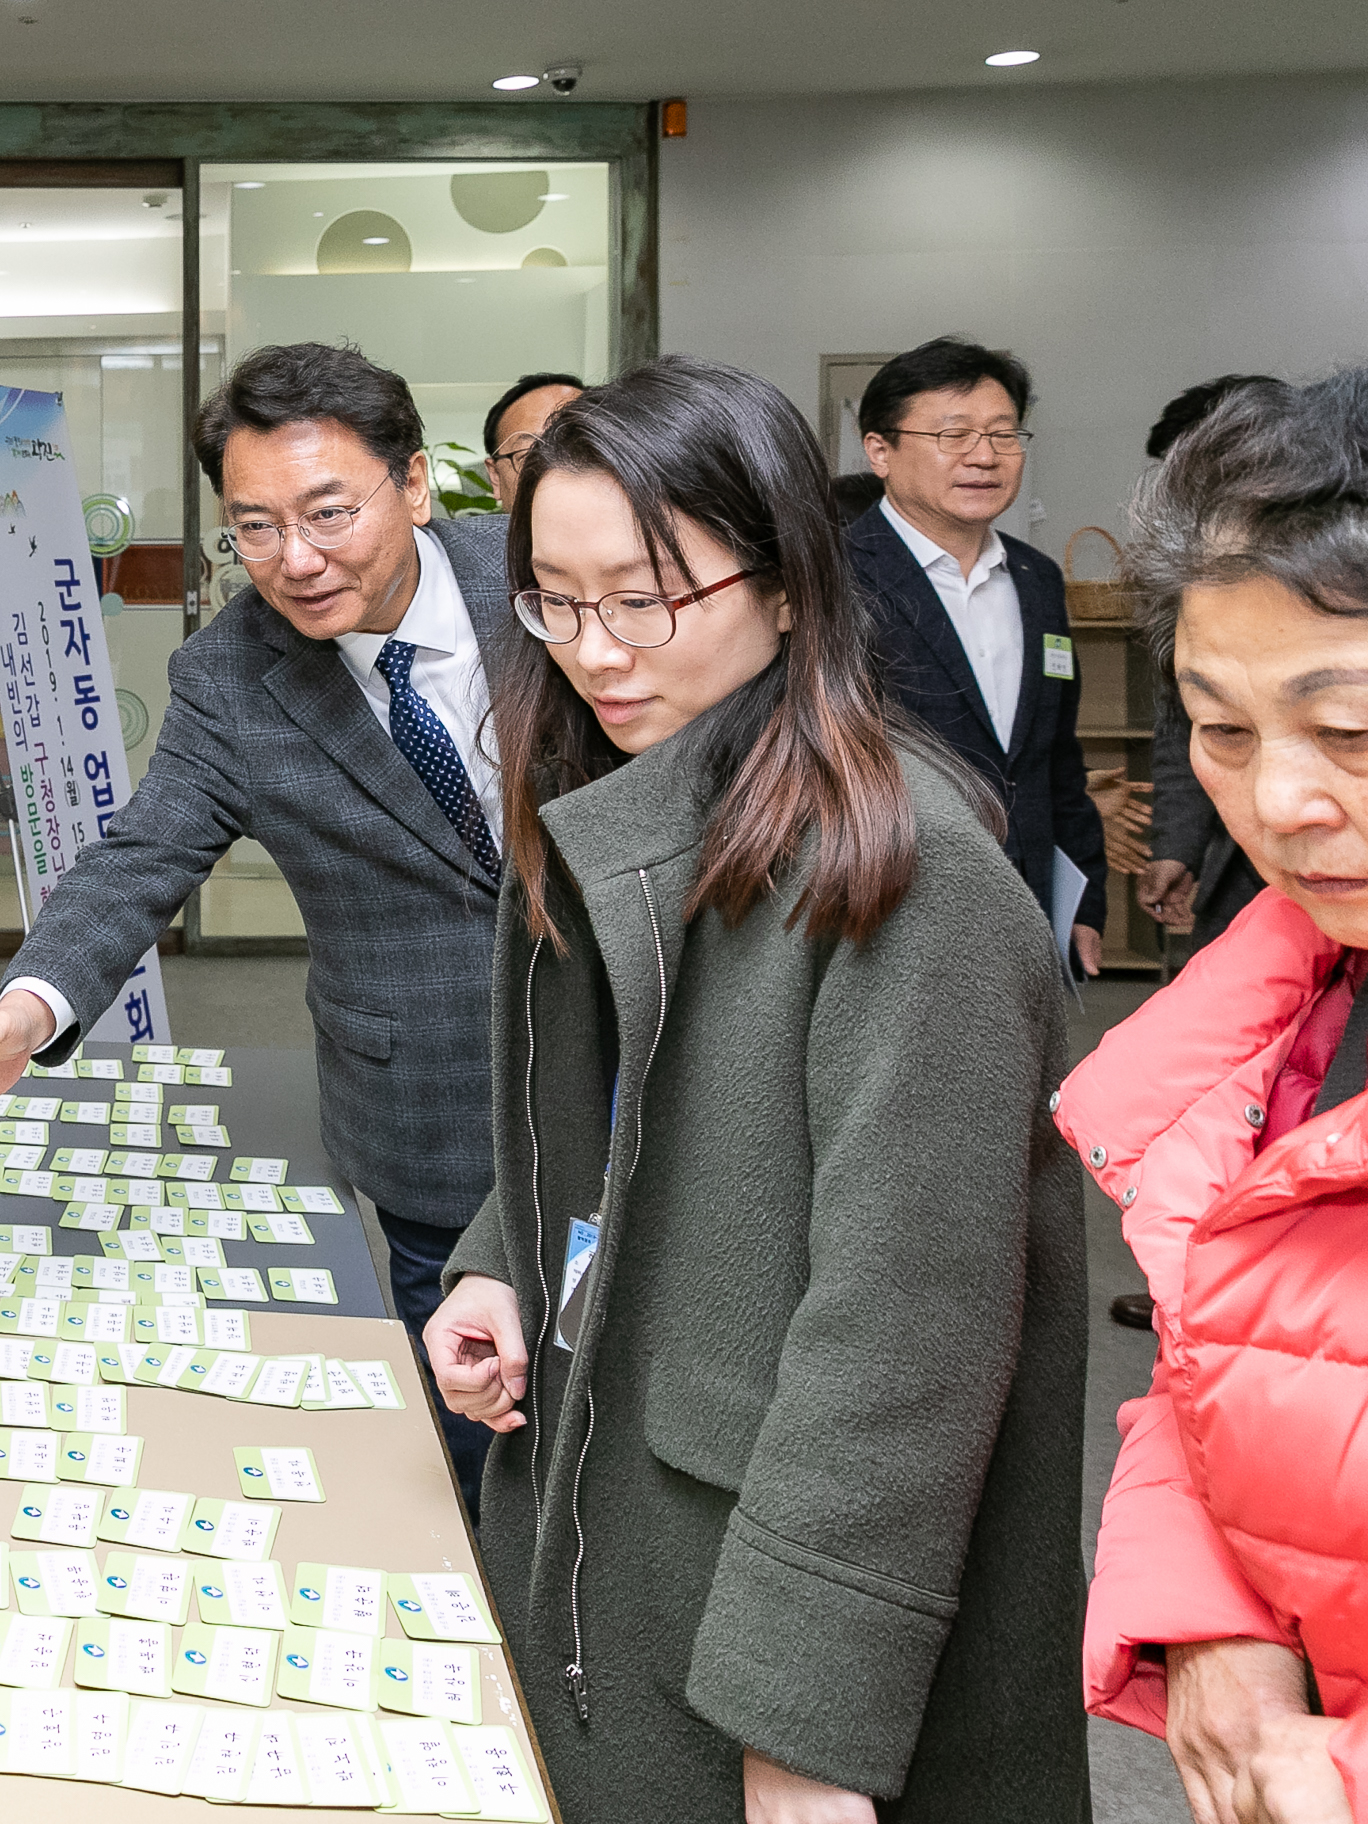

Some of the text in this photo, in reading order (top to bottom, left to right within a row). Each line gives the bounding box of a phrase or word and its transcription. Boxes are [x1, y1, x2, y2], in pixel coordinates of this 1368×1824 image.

[12, 612, 41, 728] 김선갑
[38, 601, 58, 702] 2019.
[54, 558, 101, 730] 군자동
[0, 643, 28, 752] 내빈의
[20, 763, 48, 875] 방문을
